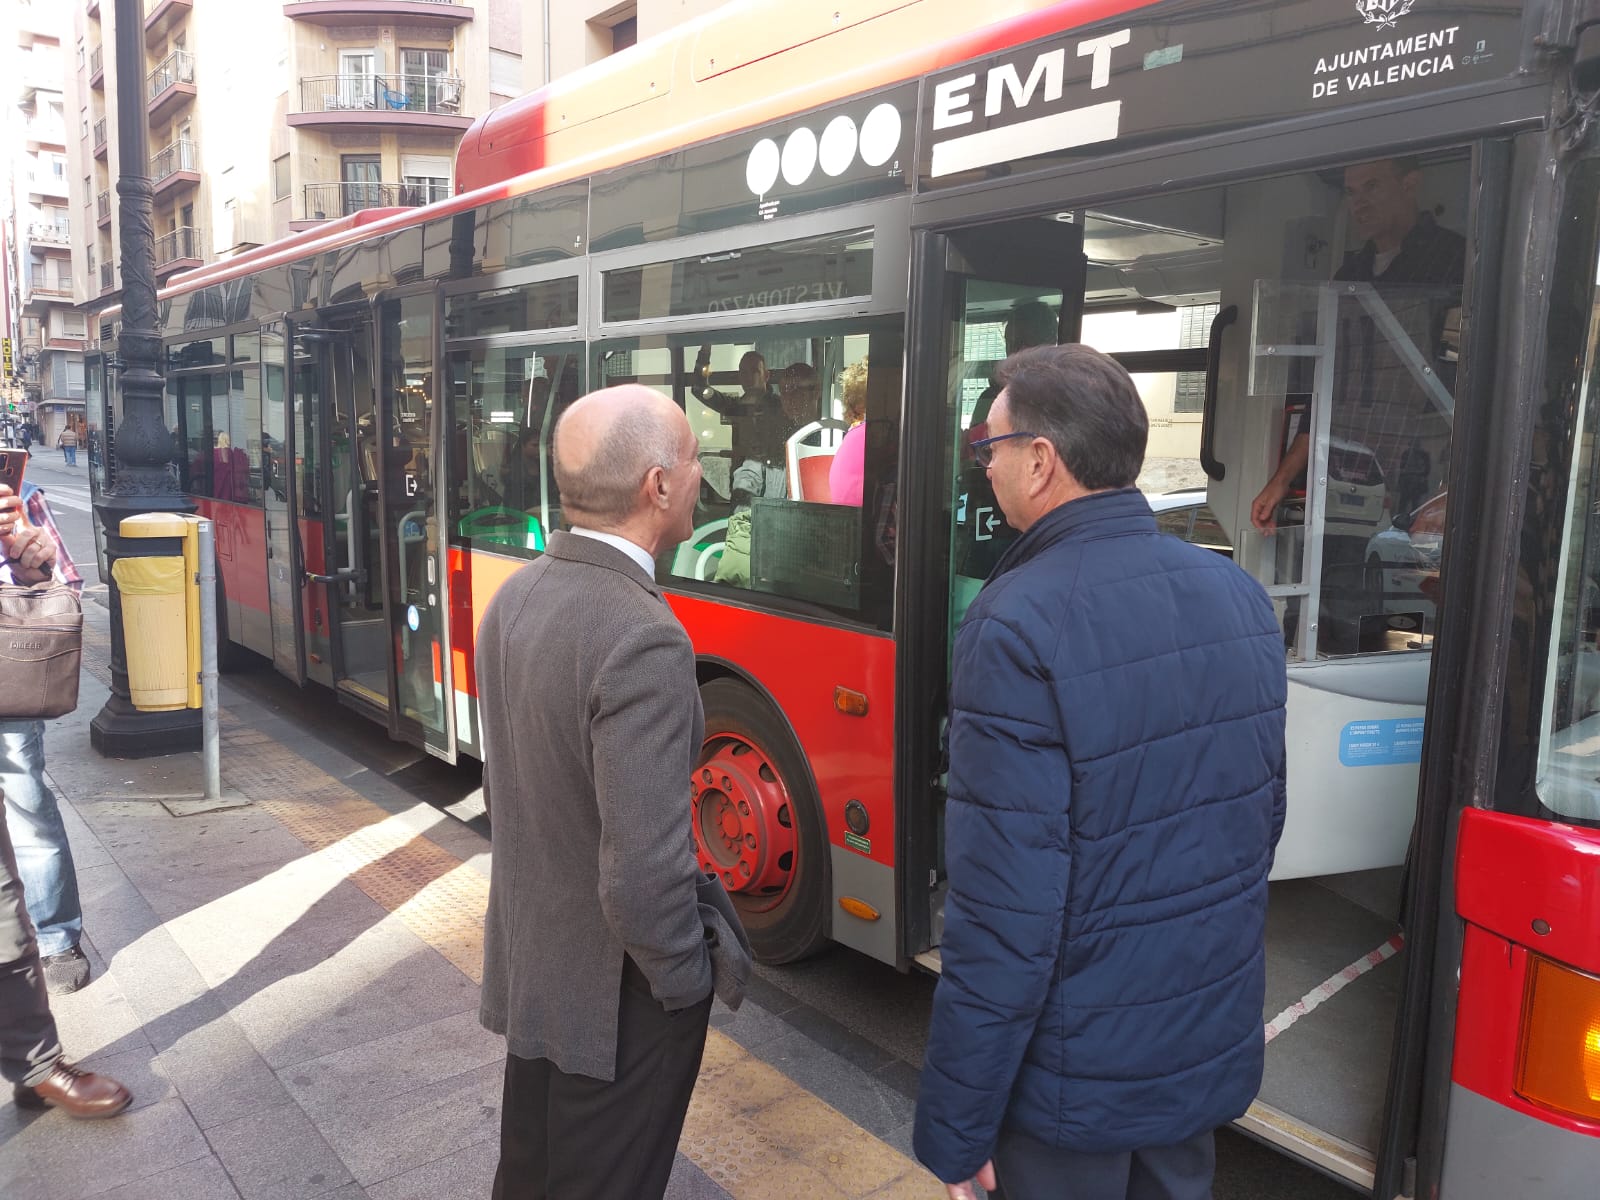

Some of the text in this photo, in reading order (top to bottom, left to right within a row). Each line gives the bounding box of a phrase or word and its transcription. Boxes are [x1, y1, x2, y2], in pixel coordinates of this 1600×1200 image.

[1313, 26, 1460, 75] AJUNTAMENT
[933, 29, 1132, 131] EMT
[1312, 78, 1340, 99] DE
[1346, 54, 1455, 91] VALENCIA
[2, 338, 13, 378] HOTEL
